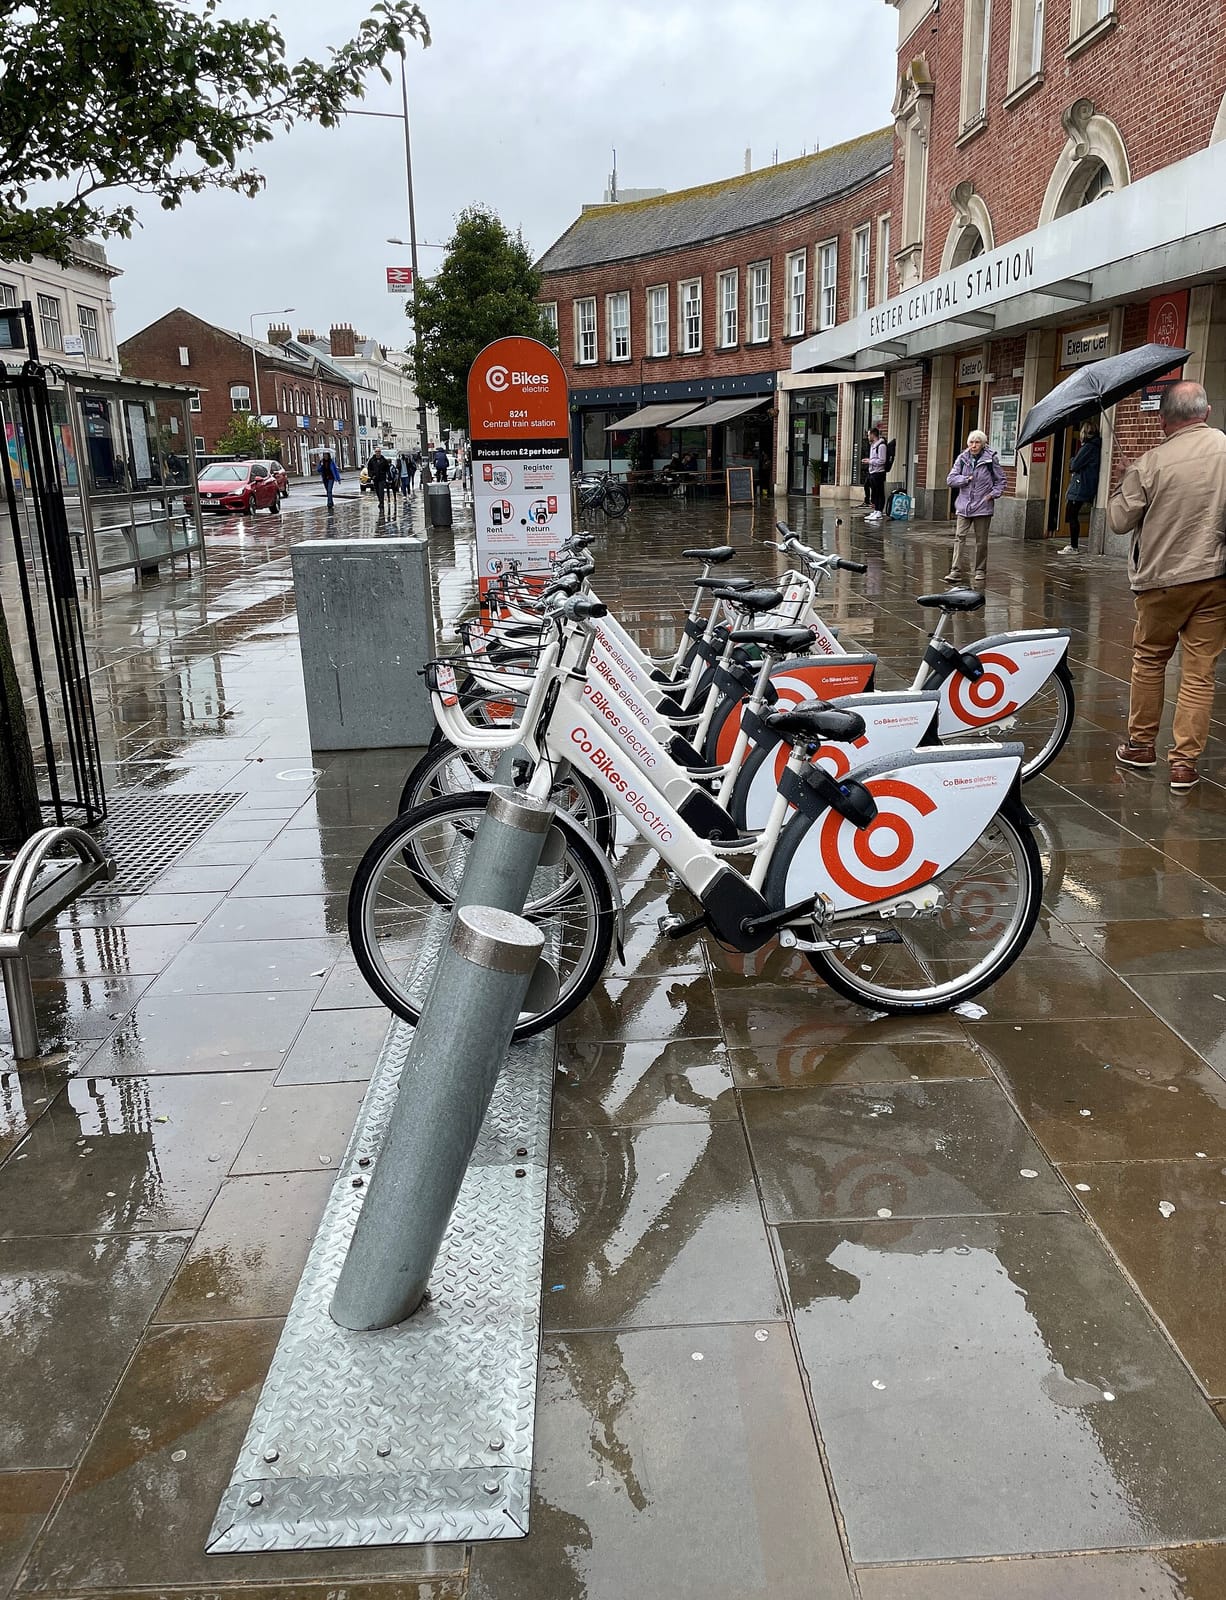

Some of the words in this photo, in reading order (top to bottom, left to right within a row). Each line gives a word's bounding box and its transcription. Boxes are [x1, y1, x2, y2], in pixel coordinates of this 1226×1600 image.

[870, 305, 903, 337] EXETER
[908, 281, 958, 322] CENTRAL
[966, 246, 1034, 299] STATION
[1161, 311, 1173, 323] THE
[1158, 321, 1175, 336] ARCH
[961, 362, 976, 376] Exeter
[511, 371, 549, 385] Bikes
[521, 385, 550, 393] electric
[509, 410, 528, 418] 8241
[483, 420, 511, 428] Central
[530, 419, 556, 427] station
[477, 449, 500, 457] Prices
[500, 448, 518, 456] from
[529, 449, 541, 457] per
[523, 464, 553, 472] Register
[611, 650, 638, 682] electric
[596, 661, 622, 691] Bikes
[618, 690, 650, 726] electric
[590, 691, 621, 727] Bikes
[618, 725, 656, 768] electric
[571, 727, 593, 753] Co
[589, 748, 628, 793] Bikes
[625, 790, 673, 842] electric
[943, 779, 953, 787] Co
[954, 778, 973, 786] Bikes
[973, 775, 997, 783] electric
